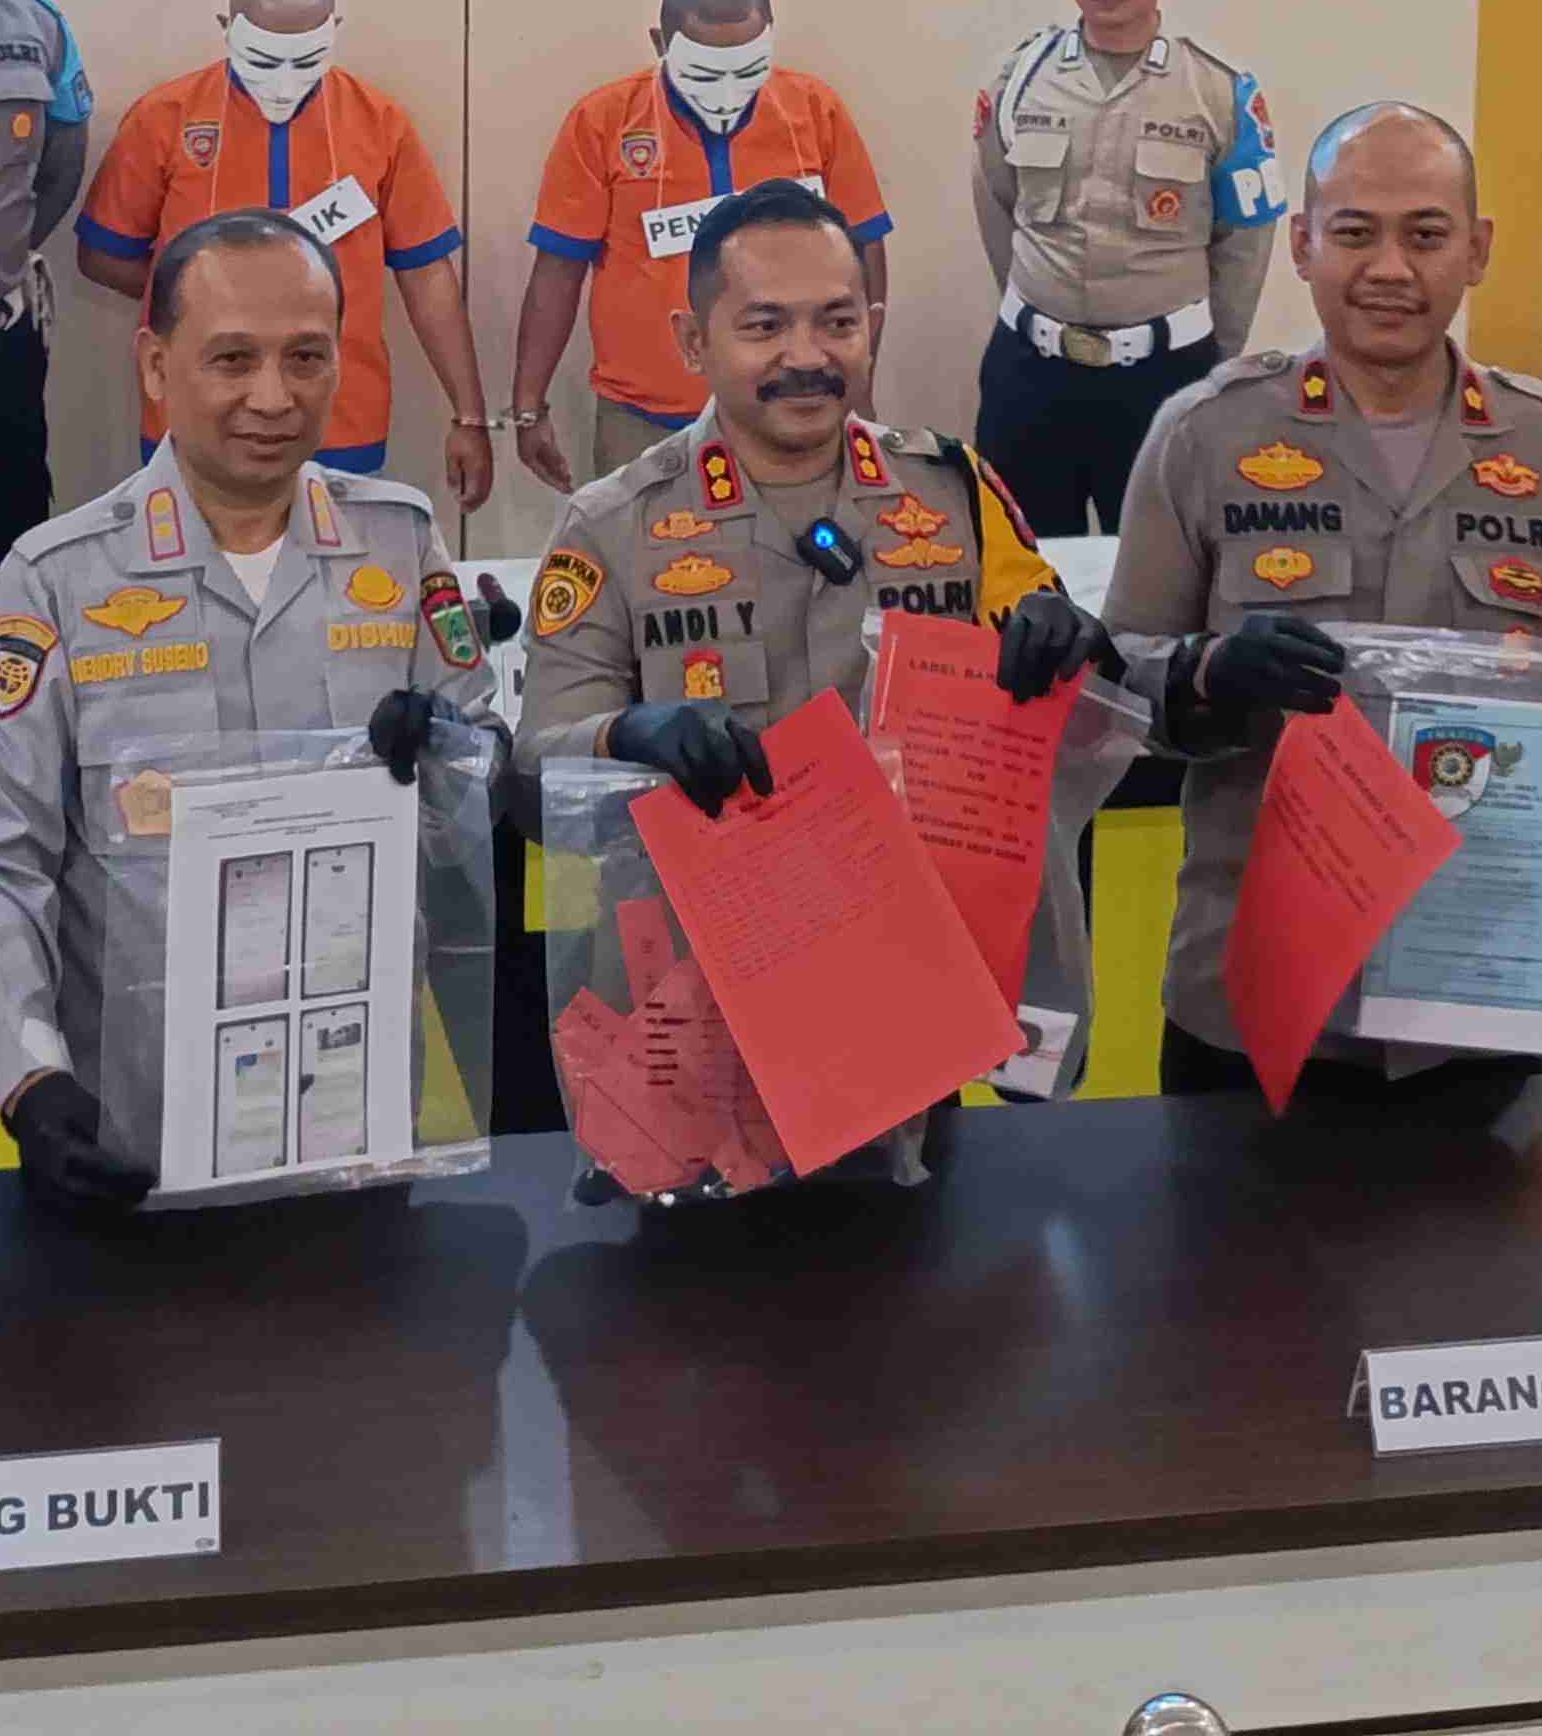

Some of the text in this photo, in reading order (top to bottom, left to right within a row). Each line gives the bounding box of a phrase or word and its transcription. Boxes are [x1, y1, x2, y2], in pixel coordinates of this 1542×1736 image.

[1144, 121, 1206, 144] POLRI
[310, 200, 348, 234] IK
[1223, 502, 1343, 534] DANANG
[878, 579, 974, 615] POLRI
[643, 600, 756, 648] ANDI Y
[47, 1481, 210, 1532] BUKTI
